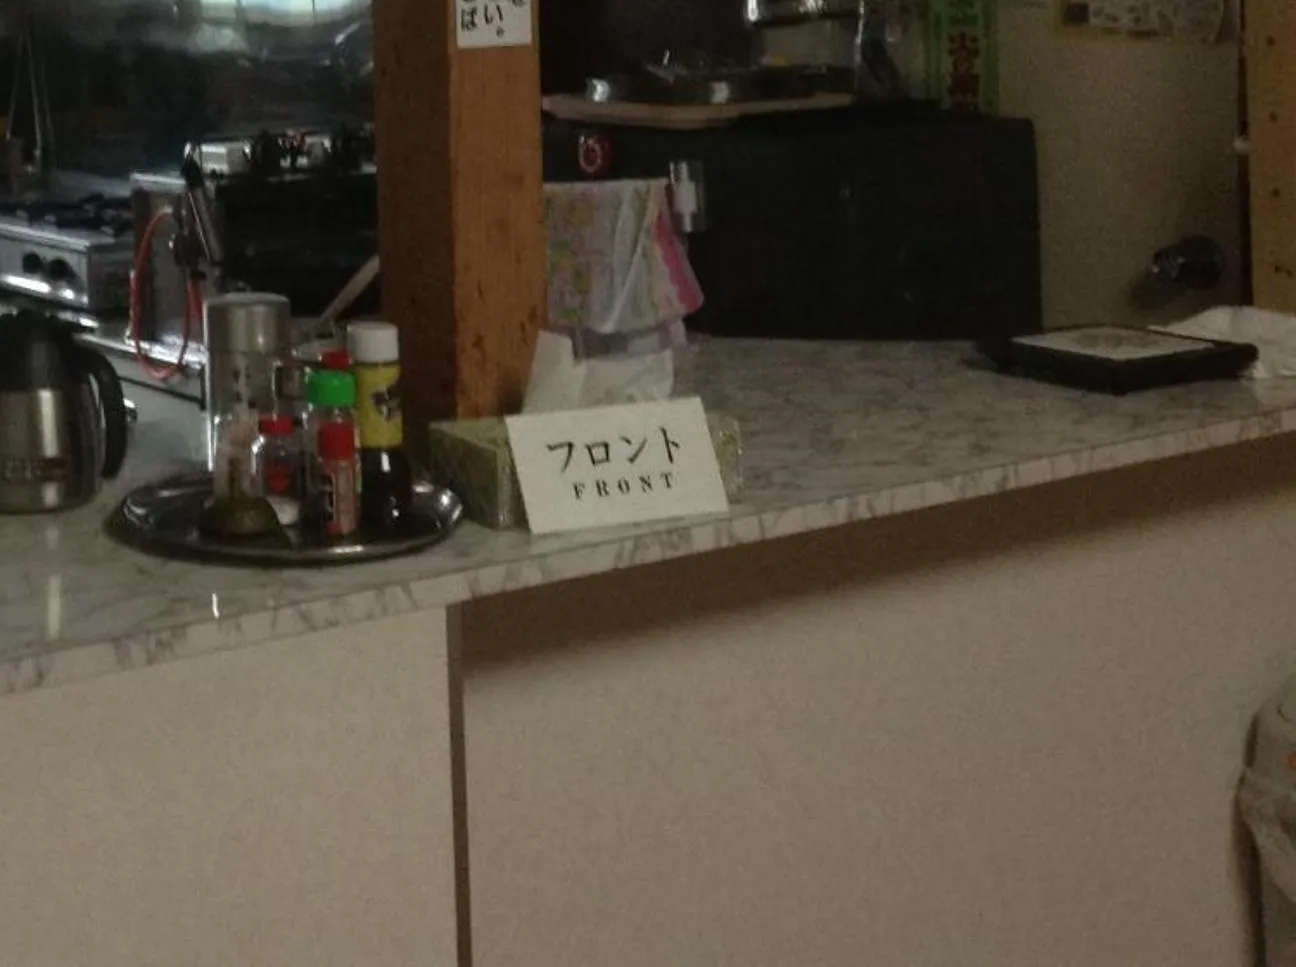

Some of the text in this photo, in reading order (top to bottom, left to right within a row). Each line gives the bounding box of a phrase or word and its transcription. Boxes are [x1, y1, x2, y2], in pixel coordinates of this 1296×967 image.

[546, 425, 682, 474] フロント
[572, 471, 675, 501] FRONT
